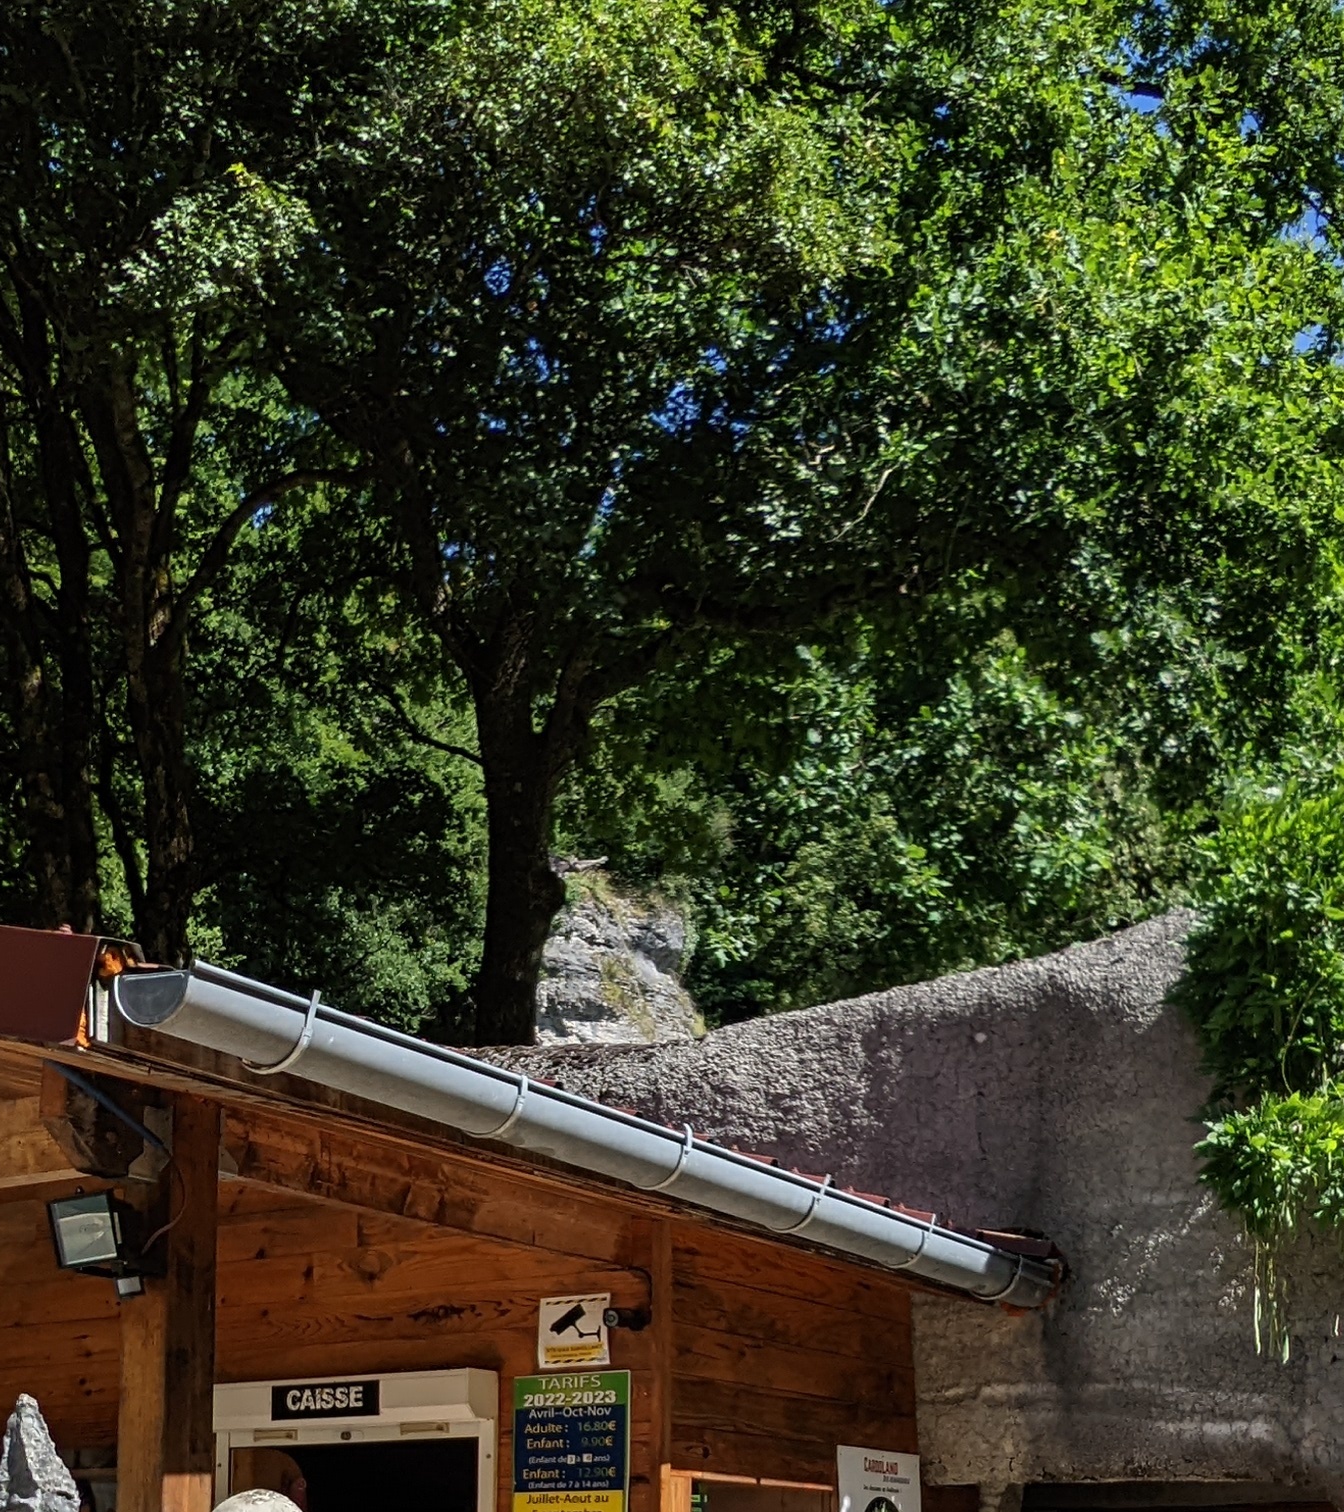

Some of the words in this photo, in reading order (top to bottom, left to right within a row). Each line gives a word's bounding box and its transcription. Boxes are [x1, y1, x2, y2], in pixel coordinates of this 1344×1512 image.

[538, 1374, 602, 1390] TARIFS
[286, 1385, 364, 1412] CAISSE
[523, 1390, 617, 1407] 2022-2023
[524, 1422, 564, 1435] Adulte
[576, 1420, 617, 1432] 16.80€
[526, 1436, 564, 1449] Enfant
[580, 1435, 614, 1447] 9.90€
[522, 1467, 560, 1480] Enfant
[577, 1466, 617, 1478] 12.90€
[526, 1493, 592, 1504] Juillet-Aout
[594, 1494, 609, 1503] au
